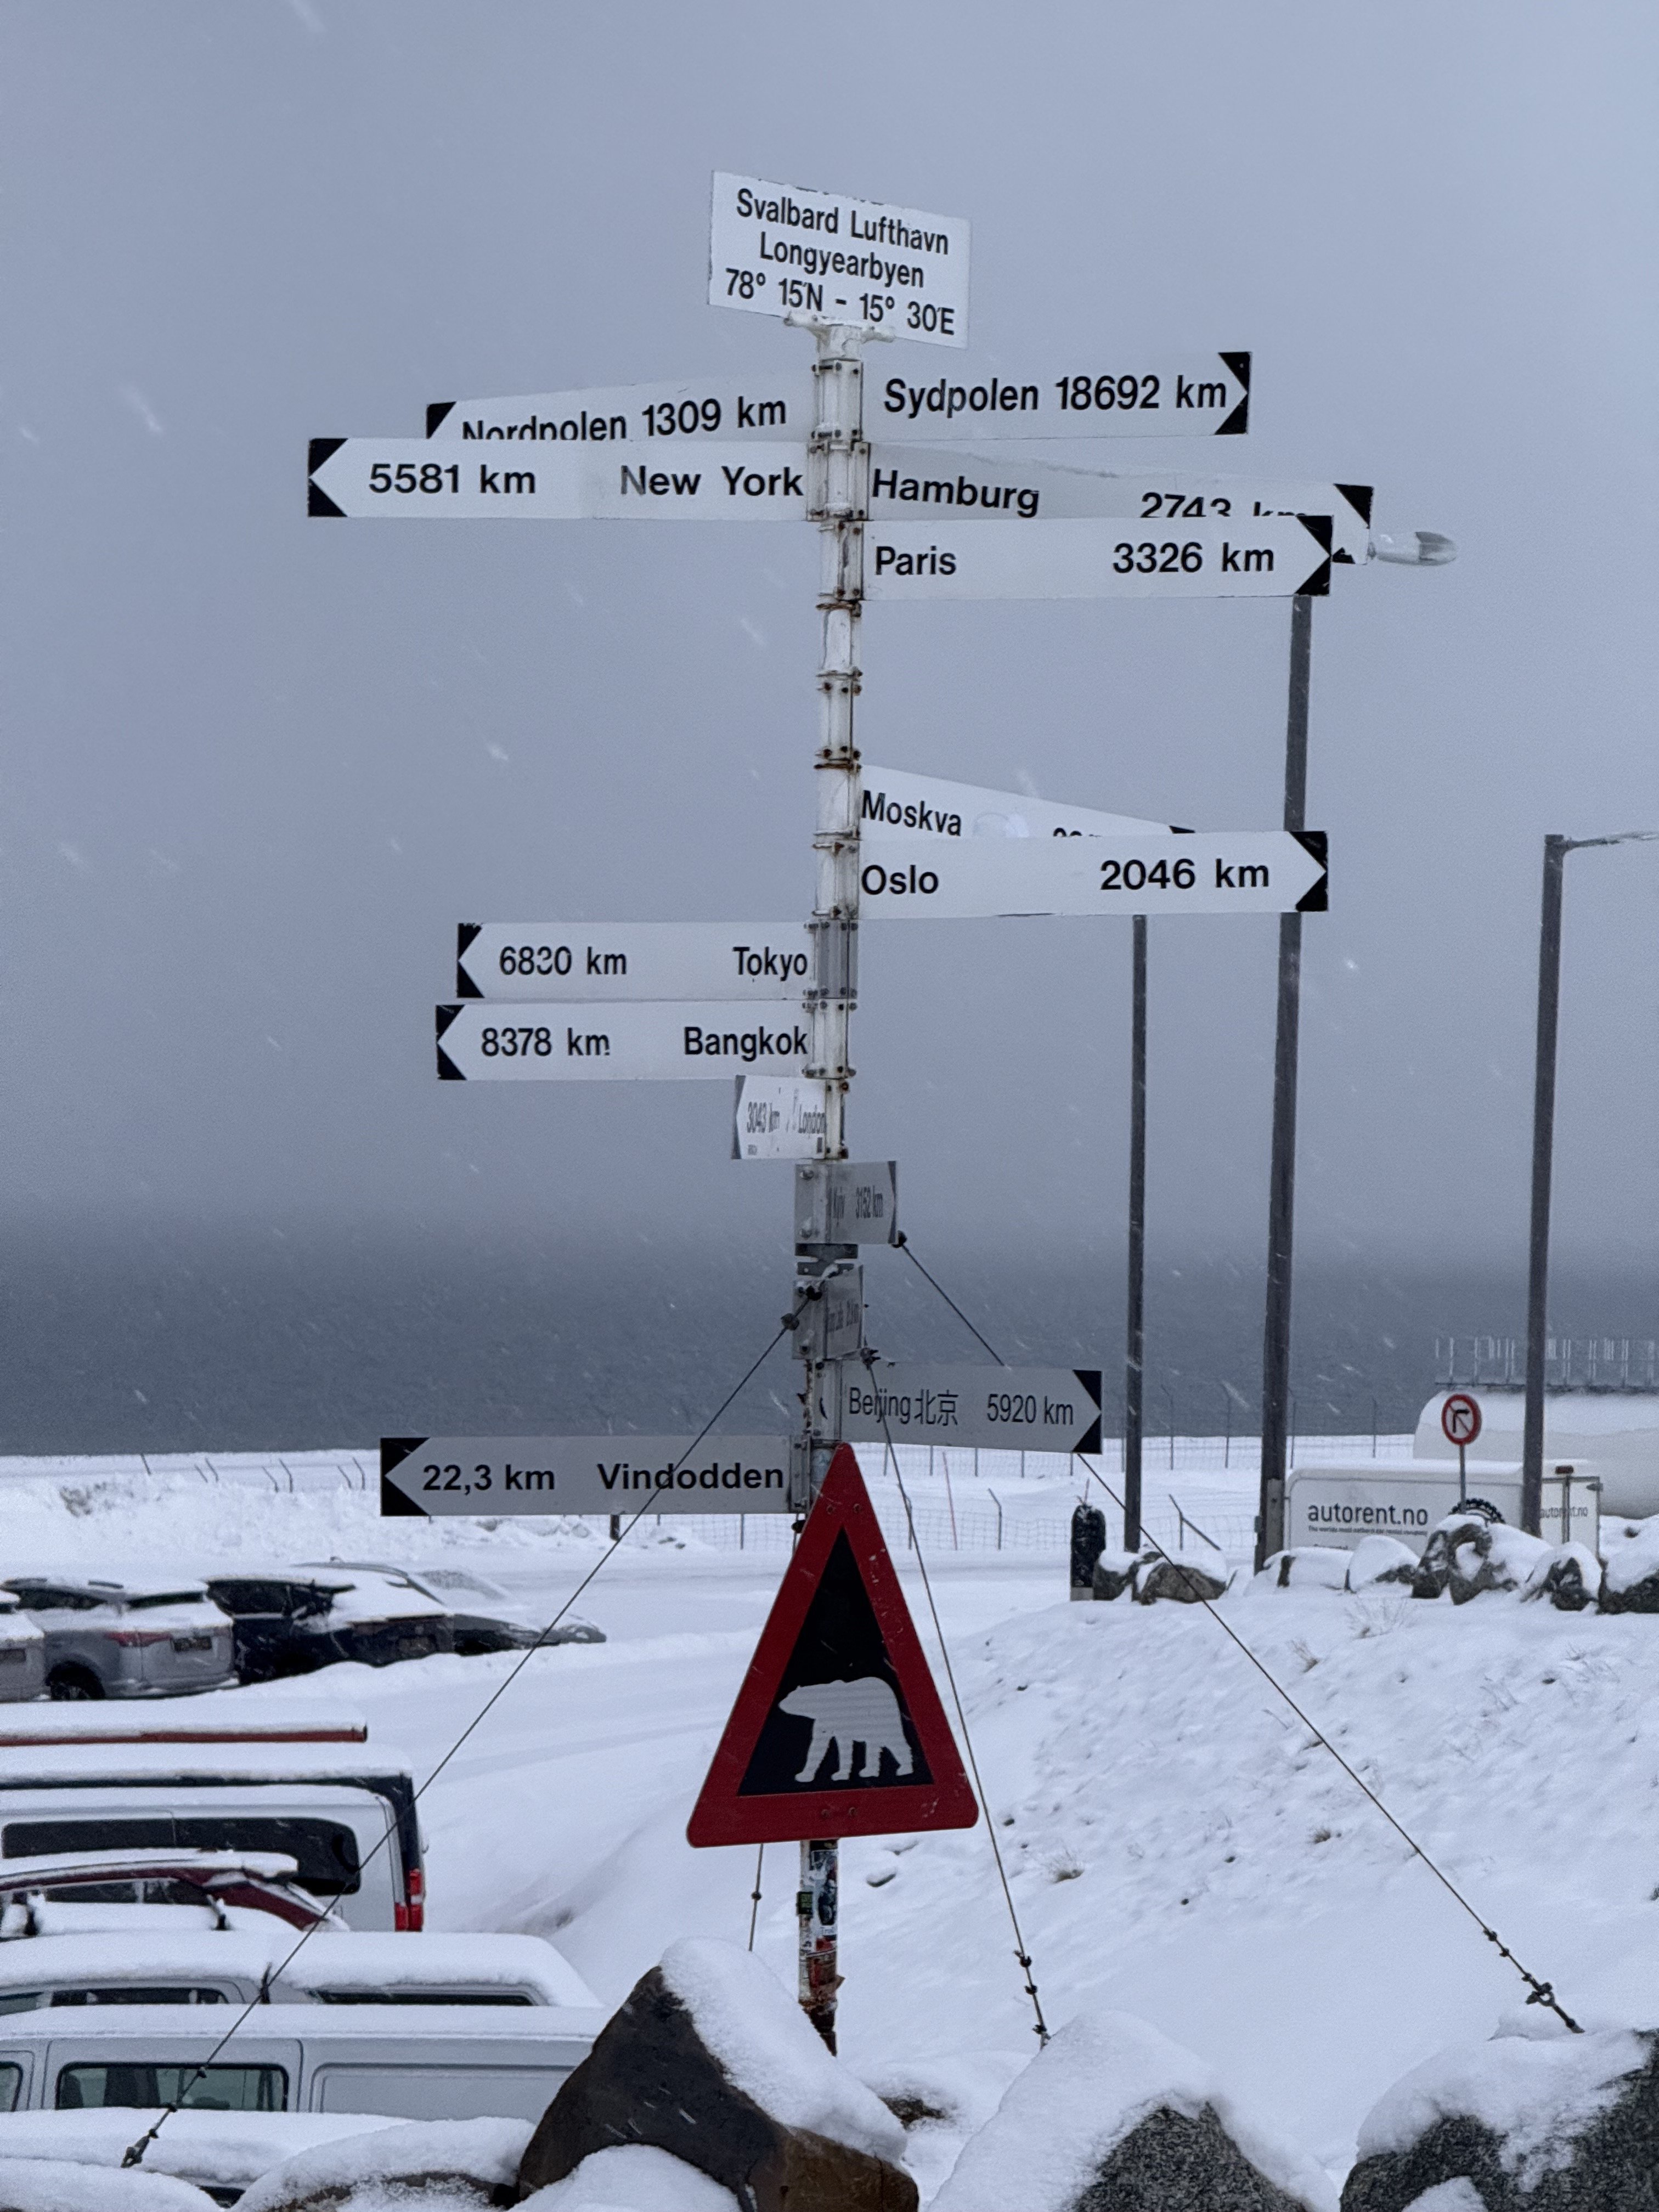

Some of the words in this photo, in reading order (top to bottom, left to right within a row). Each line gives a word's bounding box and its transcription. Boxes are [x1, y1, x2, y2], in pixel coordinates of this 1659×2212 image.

[736, 188, 839, 234] Svalbard
[851, 210, 949, 255] Lufthavn
[760, 231, 924, 288] Longyearbyen
[884, 377, 1039, 419] Sydpolen
[1056, 375, 1160, 410] 18692
[1176, 375, 1226, 409] km
[642, 398, 721, 437] 1309
[738, 396, 786, 428] km
[369, 463, 459, 494] 5581
[480, 464, 535, 494] km
[620, 465, 702, 495] New
[721, 466, 804, 496] York
[872, 469, 1039, 518] Hamburg
[1140, 492, 1231, 517] 2743
[875, 545, 956, 576] Paris
[1113, 541, 1203, 574] 3326
[1222, 542, 1274, 572] km
[862, 789, 962, 837] Moskva
[861, 865, 939, 895] Oslo
[1101, 858, 1195, 890] 2046
[1216, 858, 1269, 888] km
[499, 946, 572, 975] 6830
[586, 946, 627, 975] km
[732, 946, 808, 981] Tokyo
[481, 1027, 552, 1057] 8378
[567, 1027, 610, 1056] km
[684, 1025, 808, 1062] Bangkok
[987, 1393, 1037, 1424] 5920
[1043, 1395, 1074, 1425] km
[422, 1464, 492, 1496] 22,3
[505, 1464, 555, 1491] km
[597, 1463, 785, 1489] Vindodden
[1308, 1503, 1429, 1526] autorent.no
